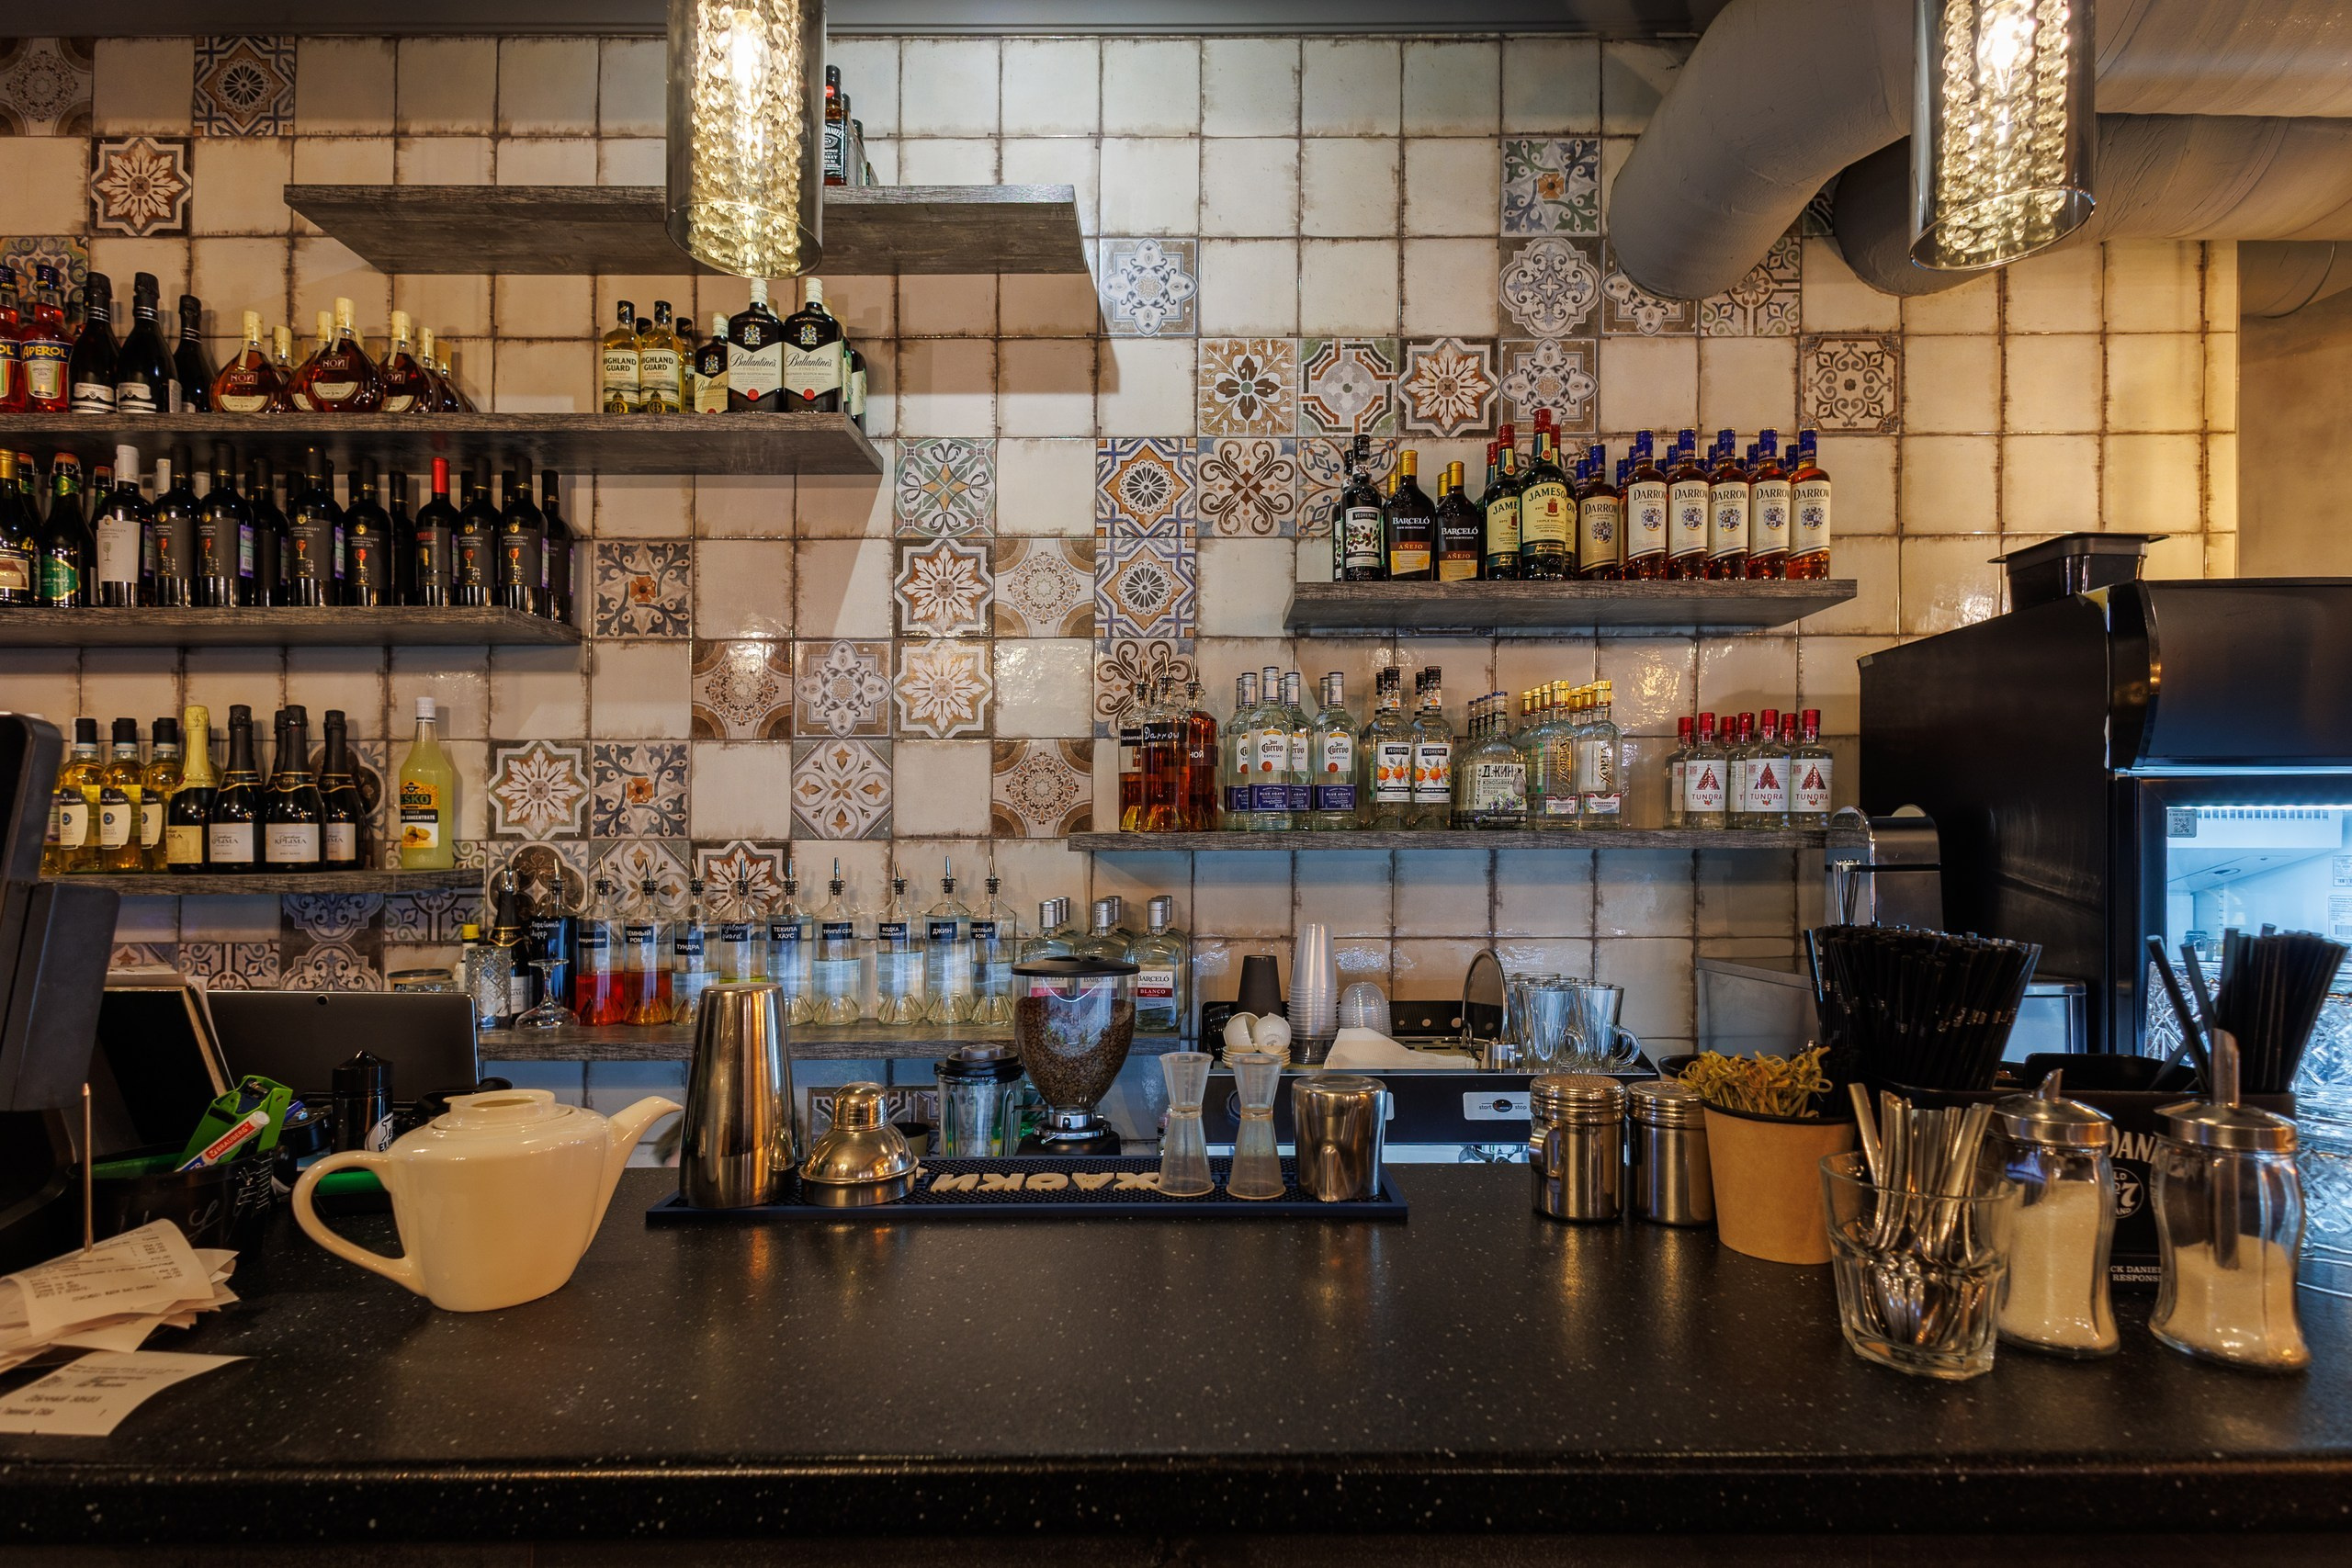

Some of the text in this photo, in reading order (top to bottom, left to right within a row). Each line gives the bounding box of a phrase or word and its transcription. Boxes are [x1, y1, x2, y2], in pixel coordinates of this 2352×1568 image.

[23, 345, 66, 358] APEROL
[729, 352, 776, 367] Ballantine's
[786, 352, 832, 367] Ballantine's
[230, 373, 254, 382] НОЙ
[386, 372, 401, 381] ОЙ
[696, 378, 728, 393] Ballantine
[1528, 487, 1566, 502] JAMESO
[1493, 502, 1517, 515] JAME
[1392, 515, 1430, 526] BARCELÓ
[1441, 526, 1478, 536] BARCELÓ
[1144, 726, 1179, 740] Darrow
[1261, 744, 1283, 753] Cuervo
[1328, 745, 1350, 755] Cuervo
[1481, 764, 1514, 778] ДЖИН
[932, 927, 953, 935] ДЖИН
[676, 942, 700, 951] ТУНДРА
[216, 1126, 249, 1152] BRAUBERG
